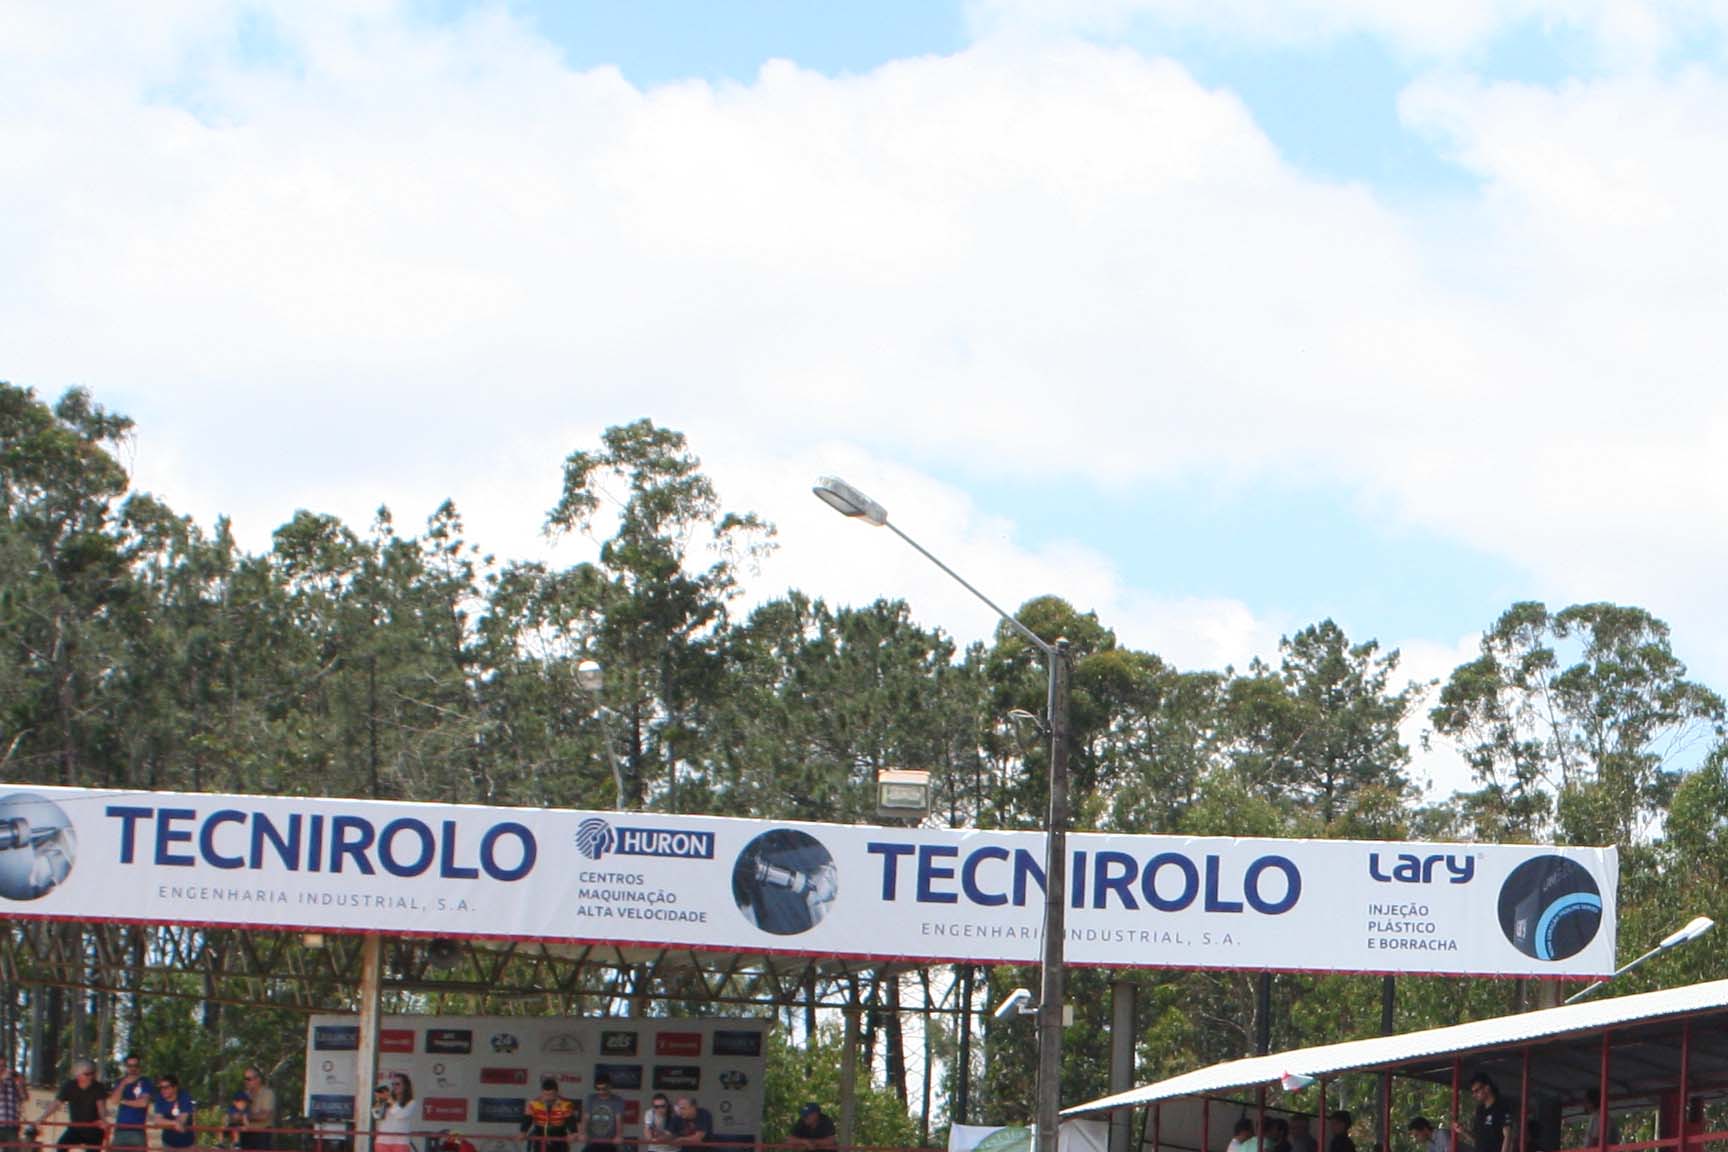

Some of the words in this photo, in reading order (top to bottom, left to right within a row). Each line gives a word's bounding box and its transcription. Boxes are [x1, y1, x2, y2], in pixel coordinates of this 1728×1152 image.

[105, 805, 538, 882] TECNIROLO
[624, 831, 708, 856] HURON
[579, 871, 645, 886] CENTROS
[867, 842, 1302, 916] TECNIROLO
[158, 886, 289, 904] ENGENHARIA
[298, 893, 428, 912] INDUSTRIAL,
[436, 898, 478, 912] S.A.
[578, 888, 678, 906] MAQUINAÇÃO
[577, 905, 615, 918] ALTA
[617, 907, 708, 923] VELOCIDADE
[1368, 902, 1430, 919] INJEÇÃO
[921, 922, 1039, 940] ENGENHARI
[1202, 931, 1242, 946] S.A.
[1368, 918, 1437, 934] PLÁSTICO
[1367, 938, 1376, 949] E
[1379, 938, 1458, 951] BORRACHA
